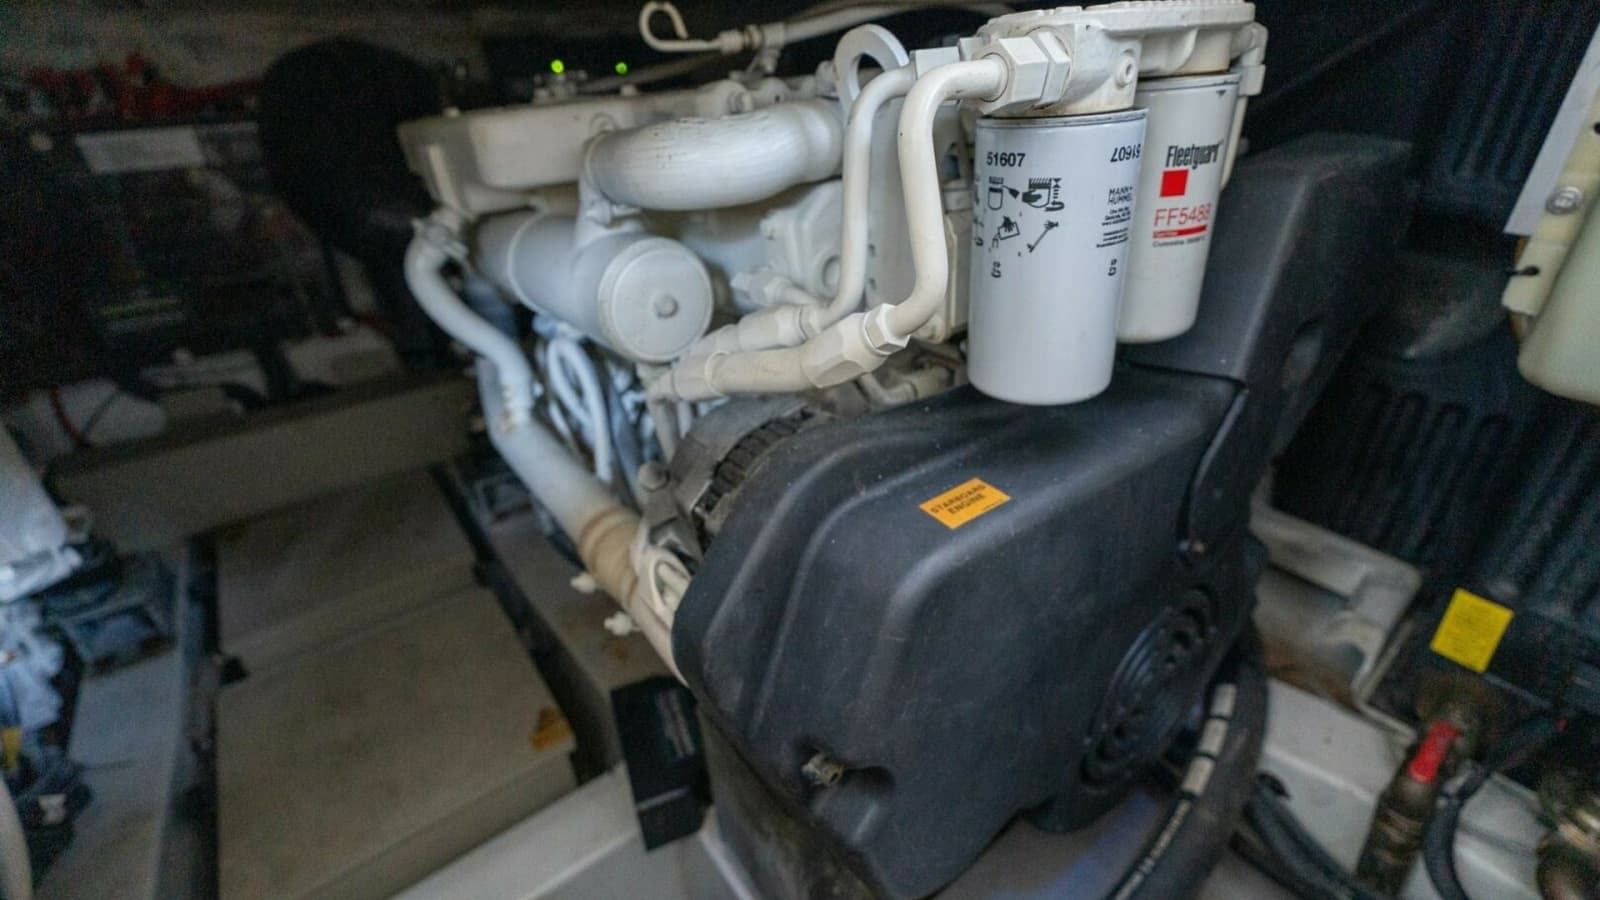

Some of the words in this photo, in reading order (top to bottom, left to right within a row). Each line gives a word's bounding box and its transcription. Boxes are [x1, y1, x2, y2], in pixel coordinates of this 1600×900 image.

[986, 152, 1026, 168] 51607
[1110, 144, 1141, 163] 51607
[930, 484, 986, 513] STARBOARD
[948, 493, 985, 514] ENGINE
